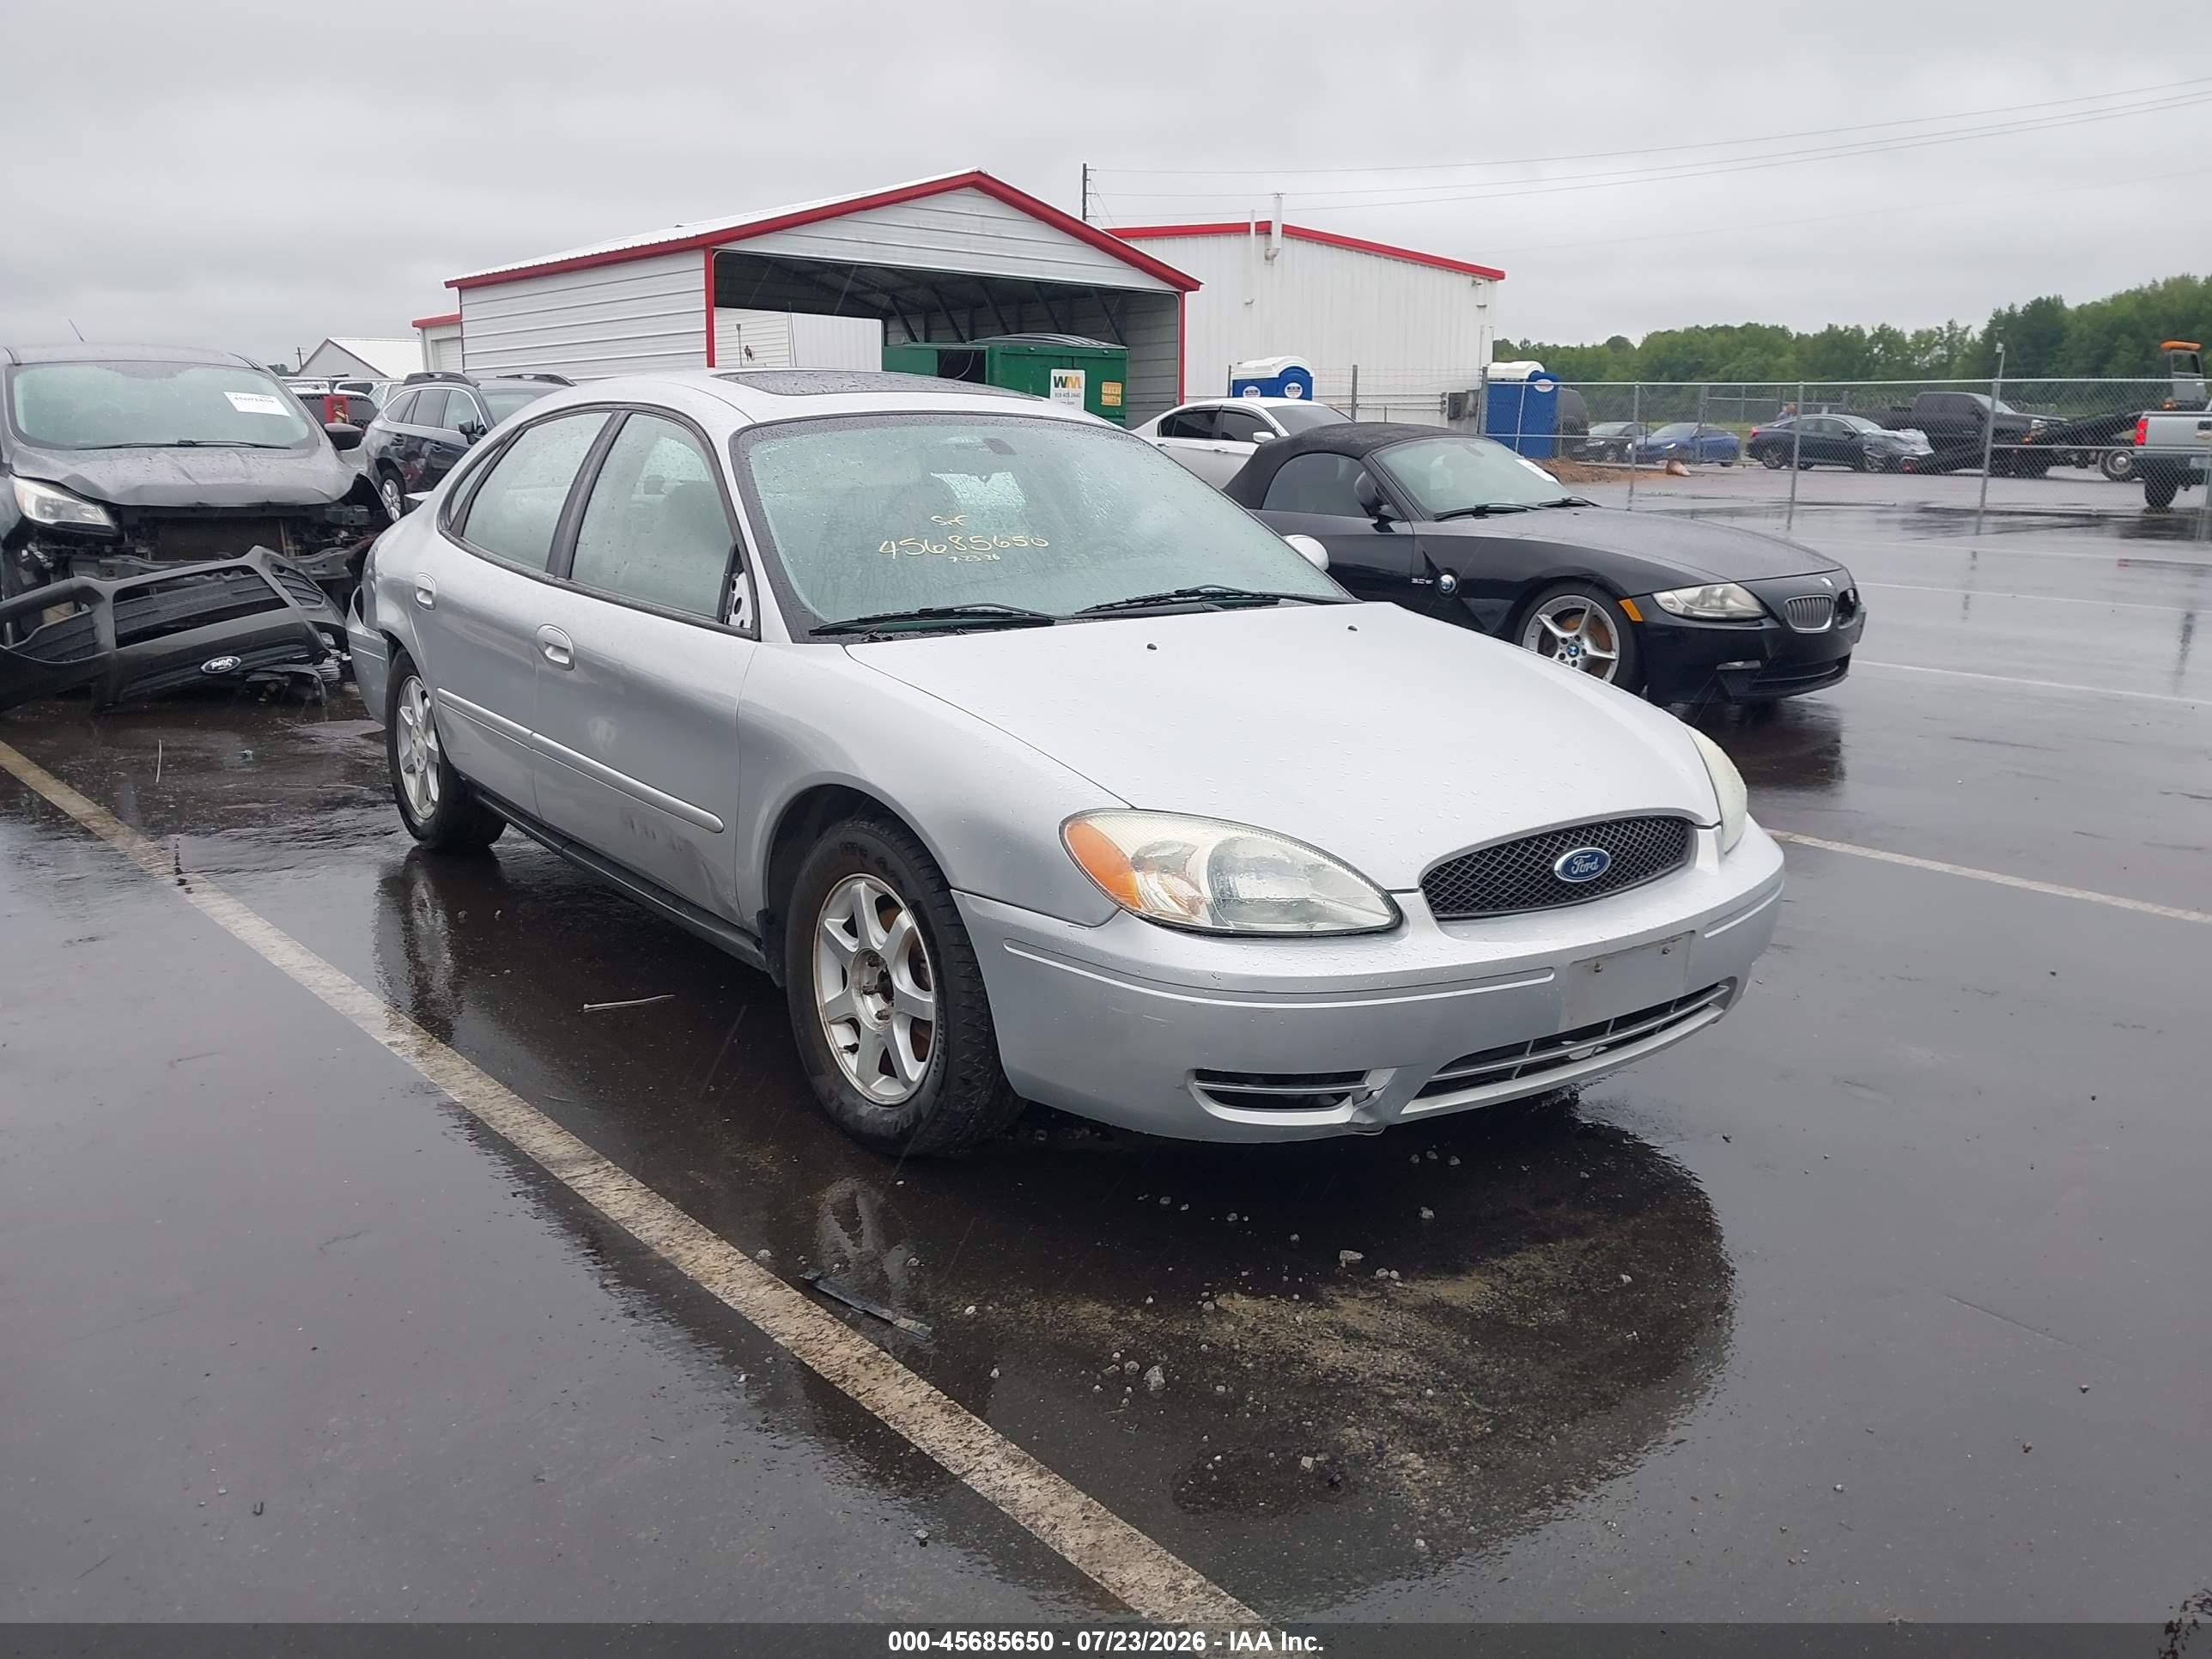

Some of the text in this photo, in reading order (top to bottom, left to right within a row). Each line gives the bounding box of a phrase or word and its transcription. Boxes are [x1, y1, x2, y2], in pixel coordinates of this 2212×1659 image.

[1054, 376, 1081, 388] WM
[878, 535, 1049, 559] 45685650
[1571, 854, 1599, 874] Ford
